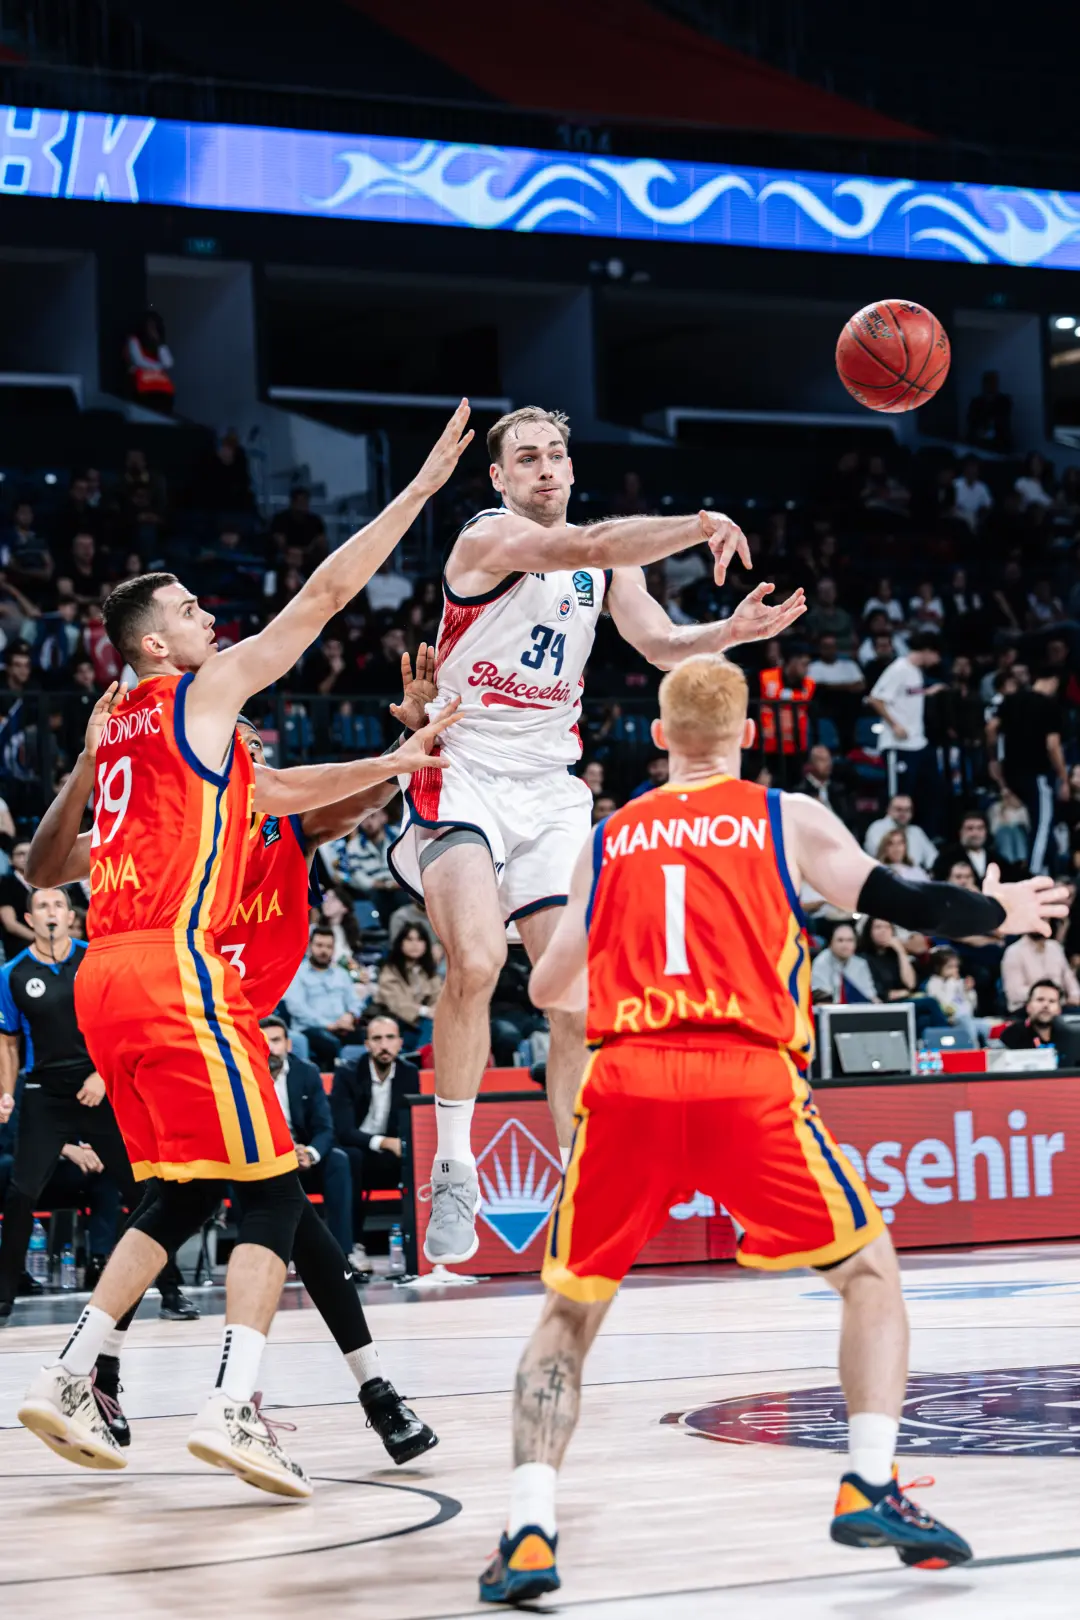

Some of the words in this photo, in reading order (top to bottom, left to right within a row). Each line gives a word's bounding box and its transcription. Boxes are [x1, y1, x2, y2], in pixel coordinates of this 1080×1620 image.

[520, 624, 566, 677] 34
[467, 660, 571, 702] Bahçeehir
[98, 702, 163, 747] MONOVIĆ
[91, 756, 133, 848] 19
[602, 814, 767, 867] MANNION
[91, 852, 141, 895] OMA
[231, 888, 284, 926] MA
[660, 864, 691, 976] 1
[613, 986, 744, 1033] ROMA
